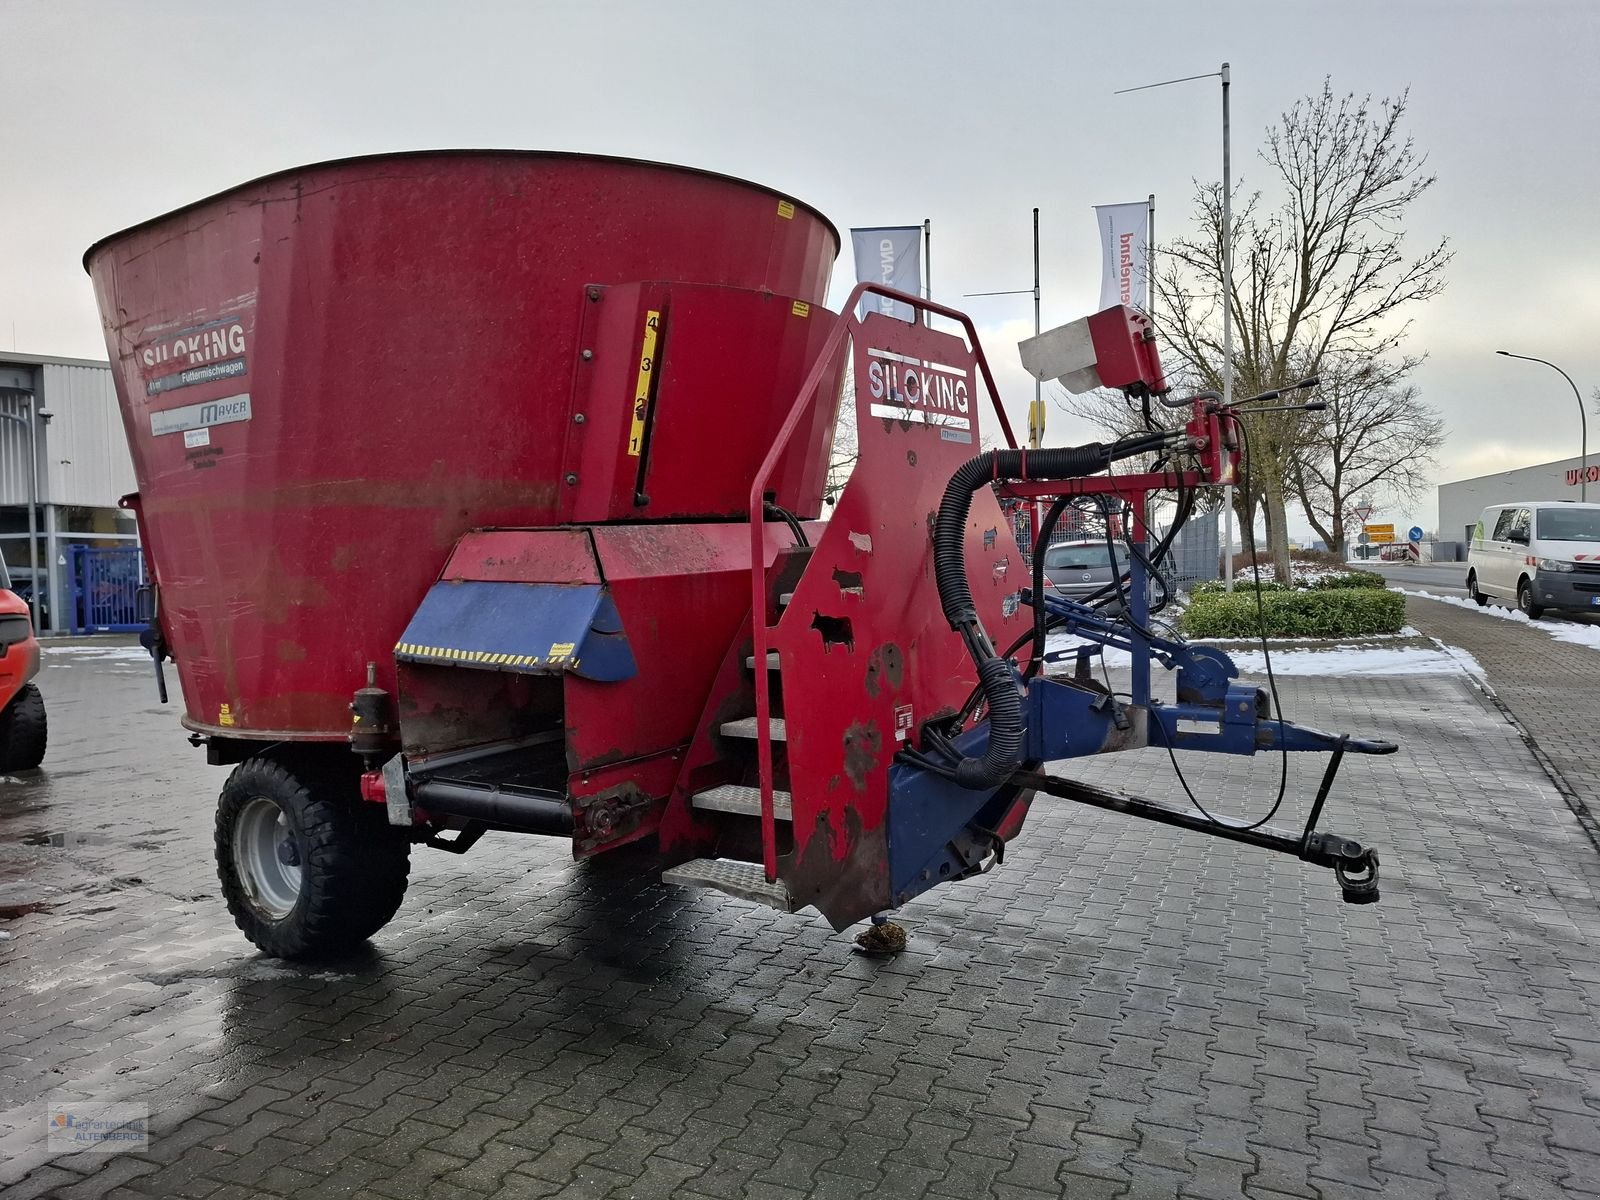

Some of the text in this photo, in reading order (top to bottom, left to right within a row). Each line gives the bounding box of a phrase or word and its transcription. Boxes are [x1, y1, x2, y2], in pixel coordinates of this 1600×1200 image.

[647, 316, 659, 329] 4
[642, 357, 652, 371] 3
[181, 361, 244, 383] Futtermischwagen
[868, 360, 969, 414] SILOKING
[635, 398, 647, 412] 2
[200, 401, 247, 425] MAYER
[631, 437, 638, 451] 1
